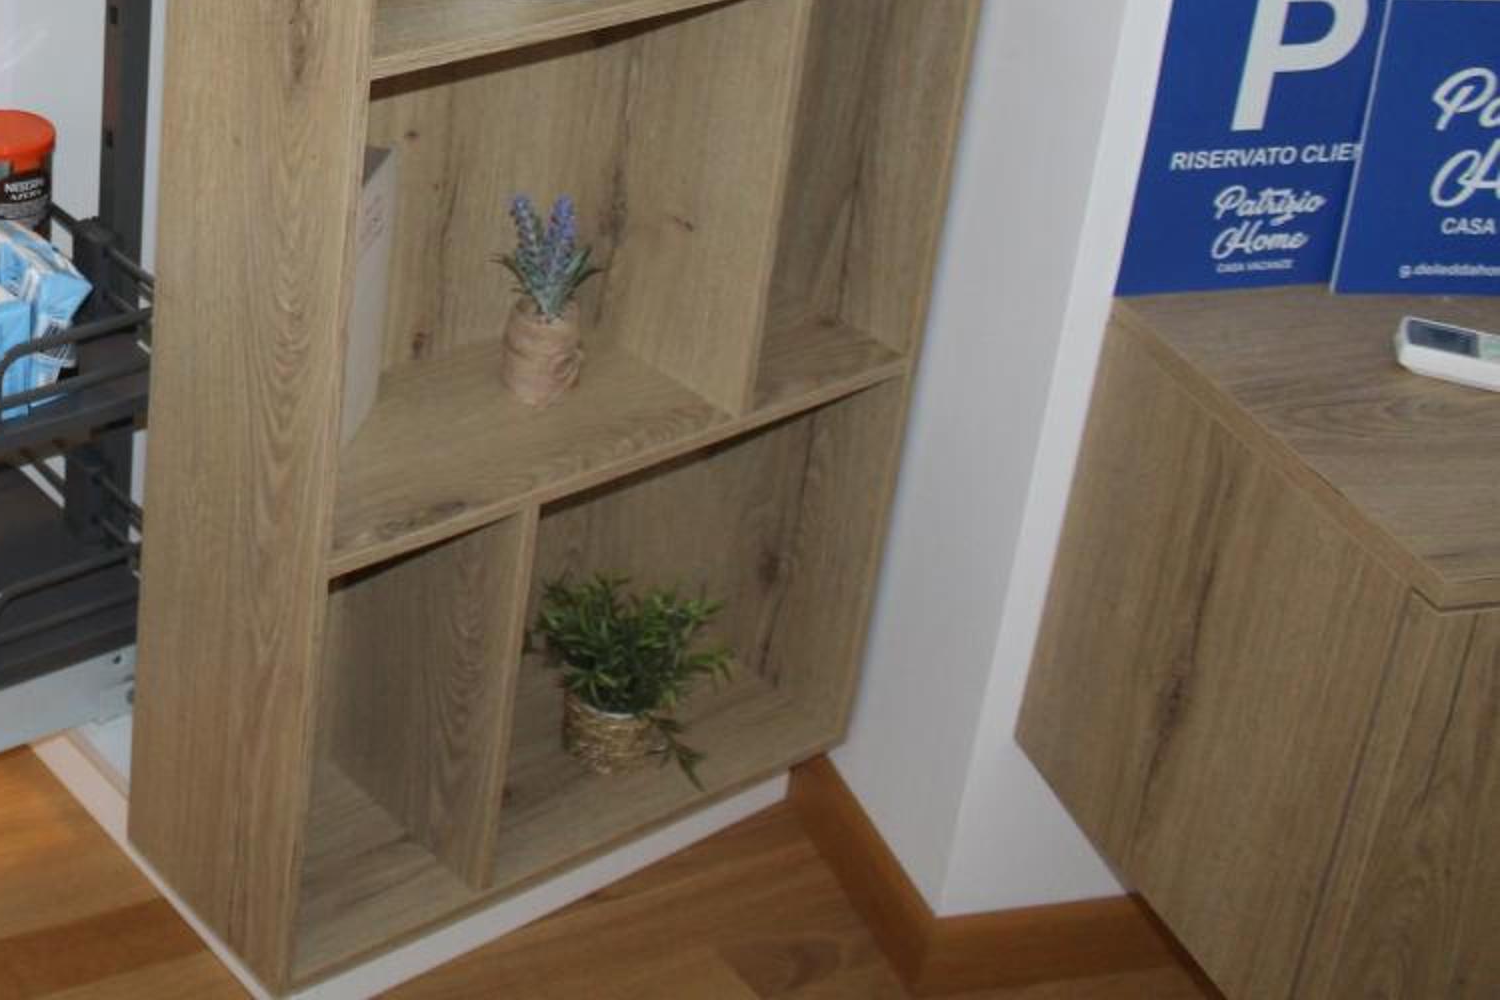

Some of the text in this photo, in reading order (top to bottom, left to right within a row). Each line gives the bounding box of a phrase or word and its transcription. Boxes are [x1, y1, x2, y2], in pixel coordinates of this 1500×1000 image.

[1170, 146, 1298, 171] RISERVATO
[1440, 217, 1497, 235] CASA
[1211, 219, 1309, 260] Home
